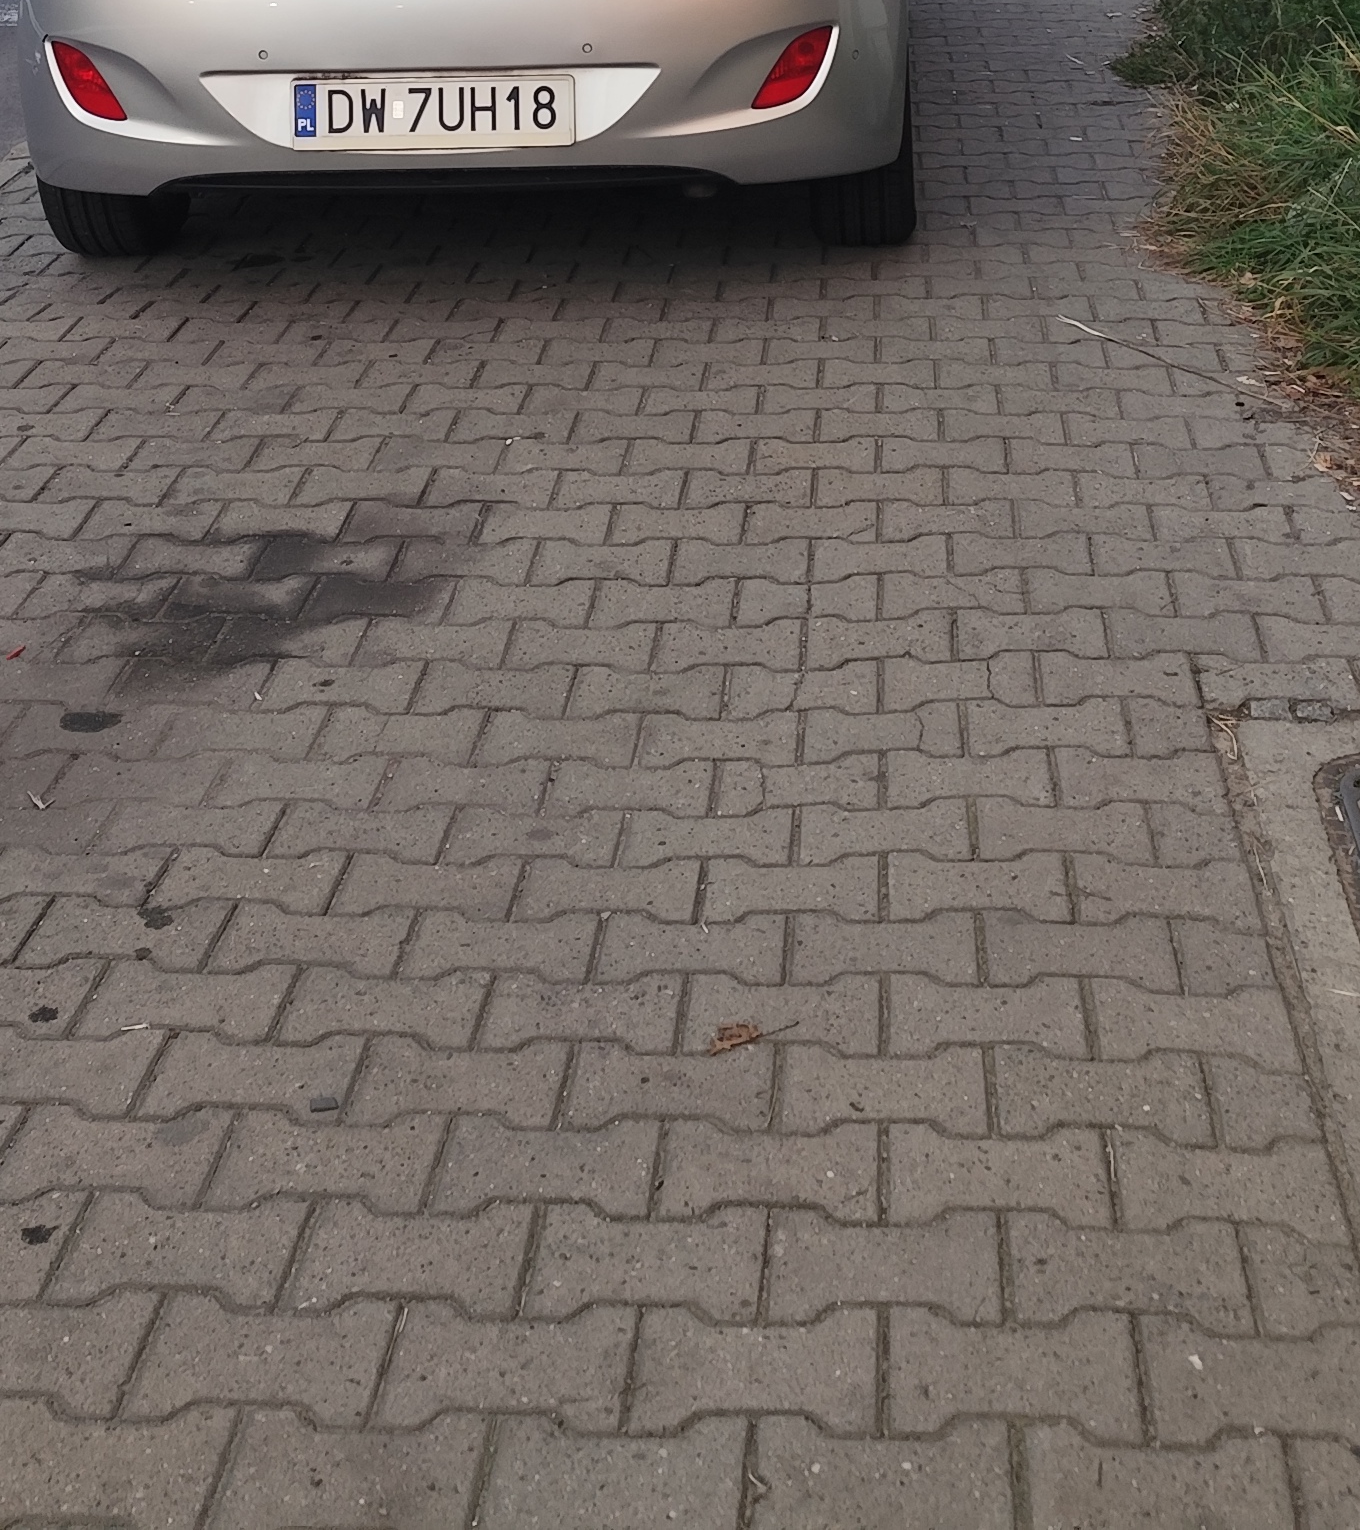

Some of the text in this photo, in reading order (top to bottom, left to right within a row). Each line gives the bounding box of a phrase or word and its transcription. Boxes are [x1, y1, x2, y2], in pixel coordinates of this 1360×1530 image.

[297, 118, 315, 132] PL
[327, 85, 557, 134] DW 7UH18
